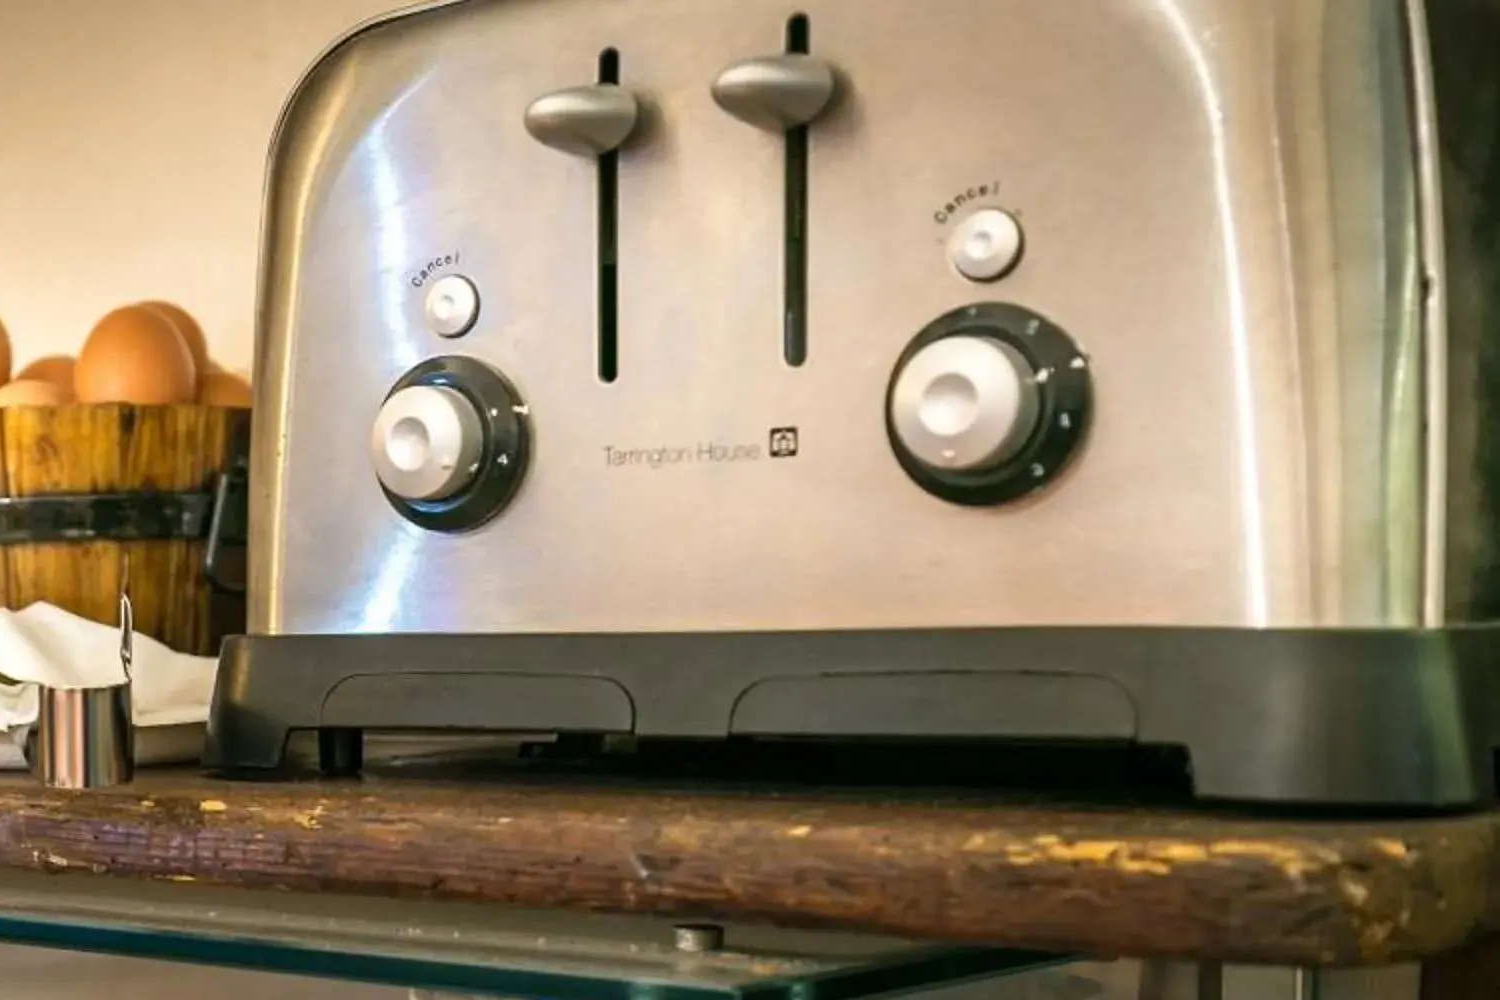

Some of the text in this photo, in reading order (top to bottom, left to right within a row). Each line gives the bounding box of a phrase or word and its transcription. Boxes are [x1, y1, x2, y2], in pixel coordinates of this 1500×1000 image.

[933, 179, 1001, 225] Cancel
[411, 248, 460, 288] Cancel
[603, 441, 762, 469] Tarrington House
